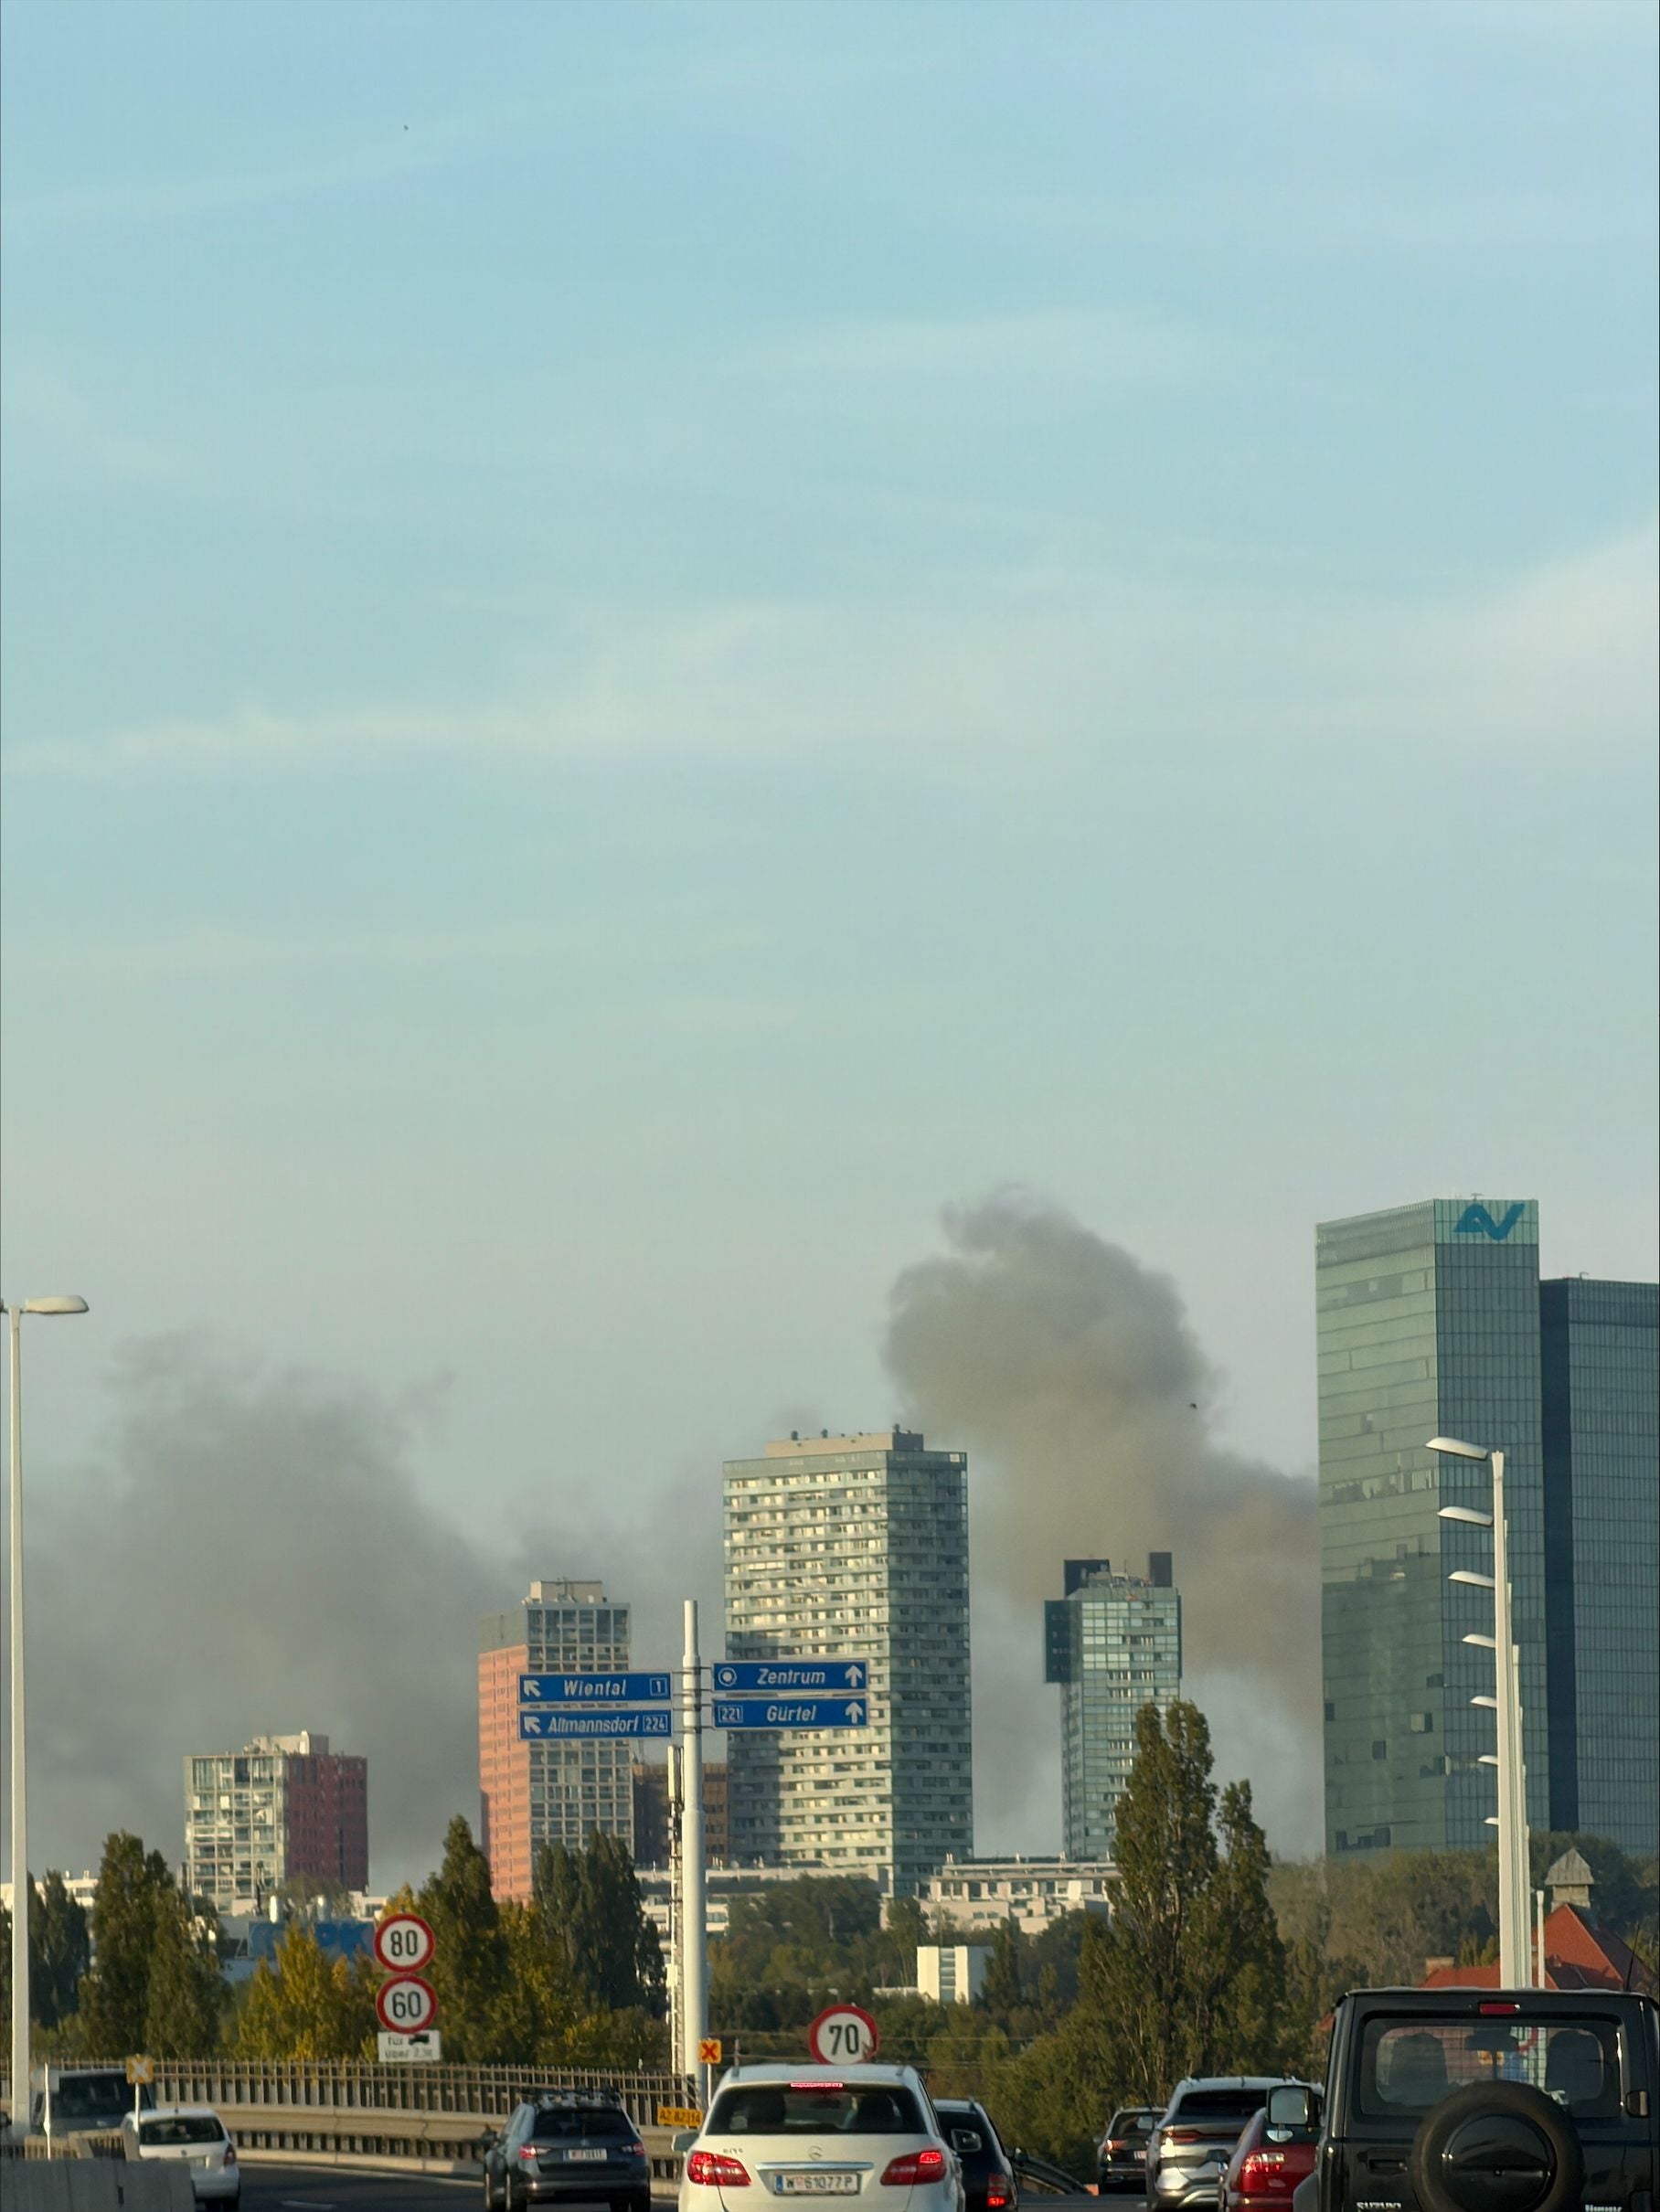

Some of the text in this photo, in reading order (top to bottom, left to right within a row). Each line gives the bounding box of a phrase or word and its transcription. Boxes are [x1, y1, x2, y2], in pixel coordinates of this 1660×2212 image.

[757, 1668, 826, 1685] Zentrum
[563, 1678, 663, 1696] Wiental 1
[720, 1704, 817, 1722] 221 Gürtel
[548, 1715, 666, 1734] Altmannsdorf 224
[389, 1929, 419, 1957] 80
[391, 1990, 422, 2019] 60
[829, 2023, 860, 2056] 70
